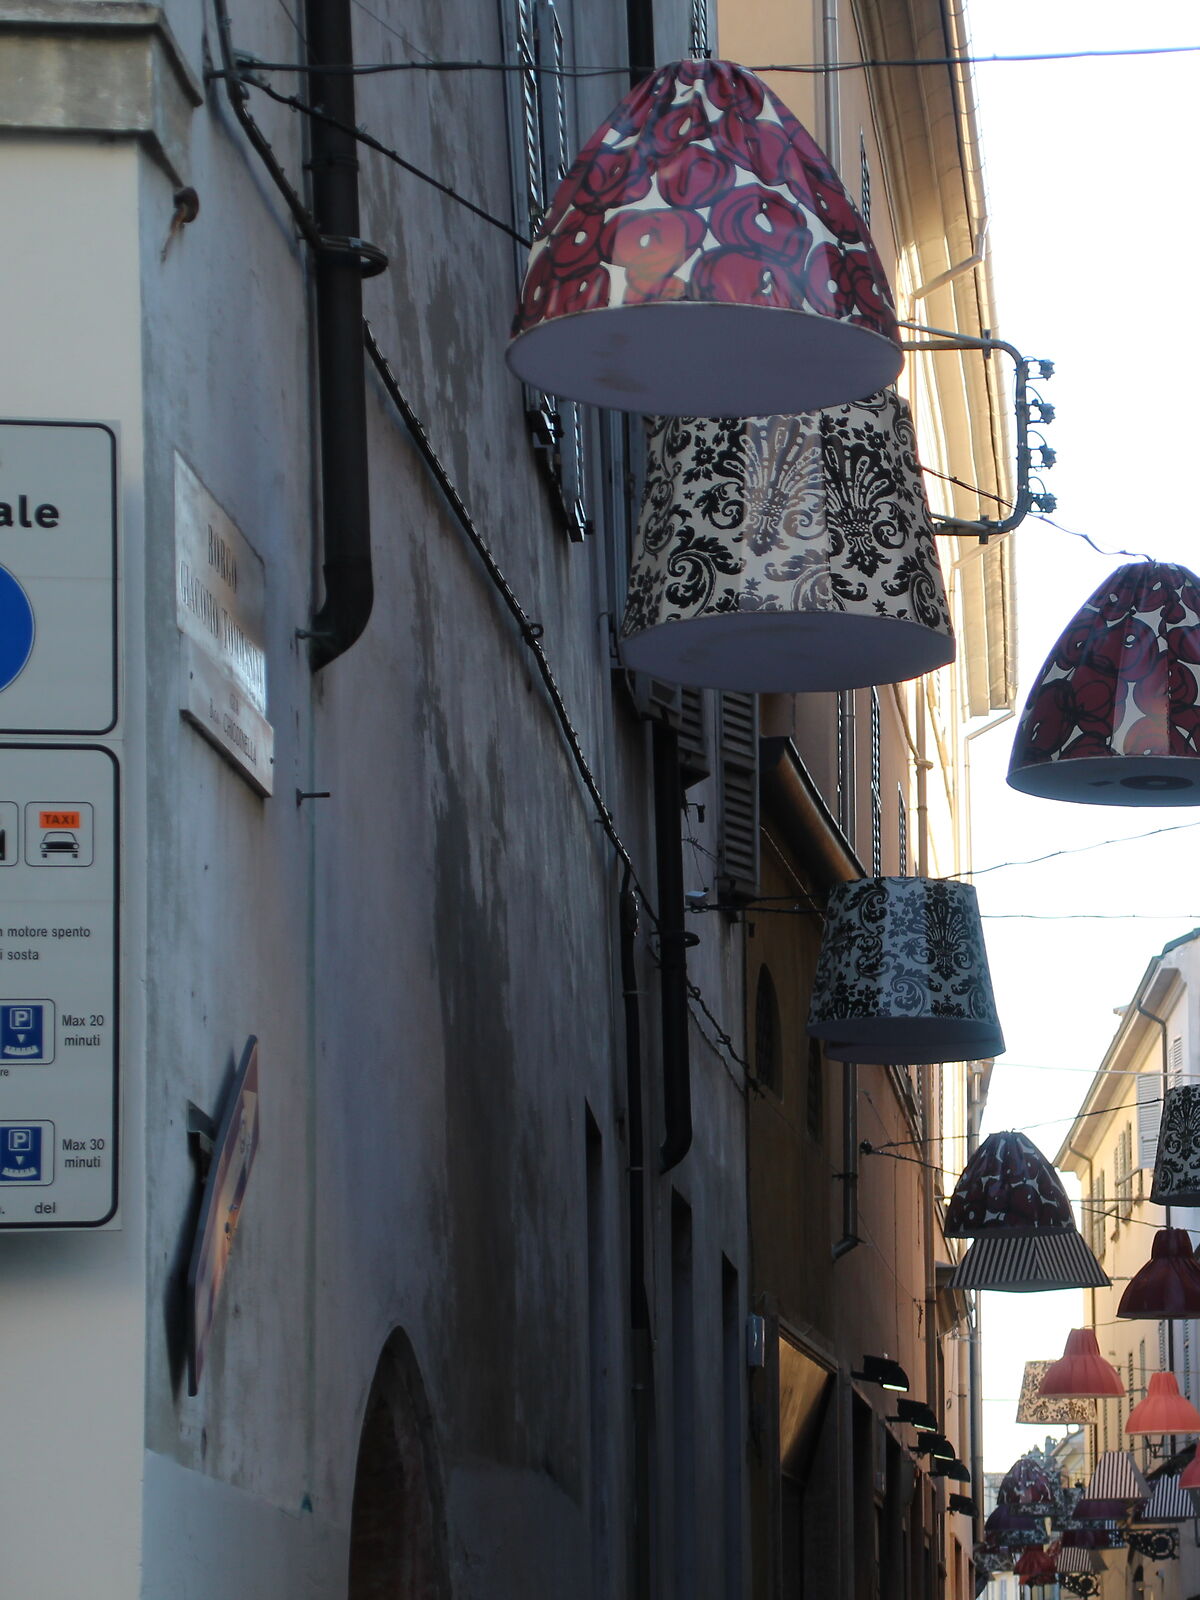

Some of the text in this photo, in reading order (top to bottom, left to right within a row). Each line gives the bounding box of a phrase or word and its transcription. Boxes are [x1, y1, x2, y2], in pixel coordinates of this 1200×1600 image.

[208, 524, 237, 594] BORGO
[44, 814, 75, 825] TAXI
[7, 925, 48, 937] motore
[51, 926, 91, 940] spento
[7, 949, 39, 960] sosta
[14, 1010, 28, 1026] P
[62, 1014, 104, 1026] Max 20
[64, 1034, 101, 1046] minuti
[13, 1132, 27, 1148] P
[62, 1138, 105, 1151] Max 30
[64, 1156, 101, 1168] minuti
[34, 1202, 56, 1214] del
